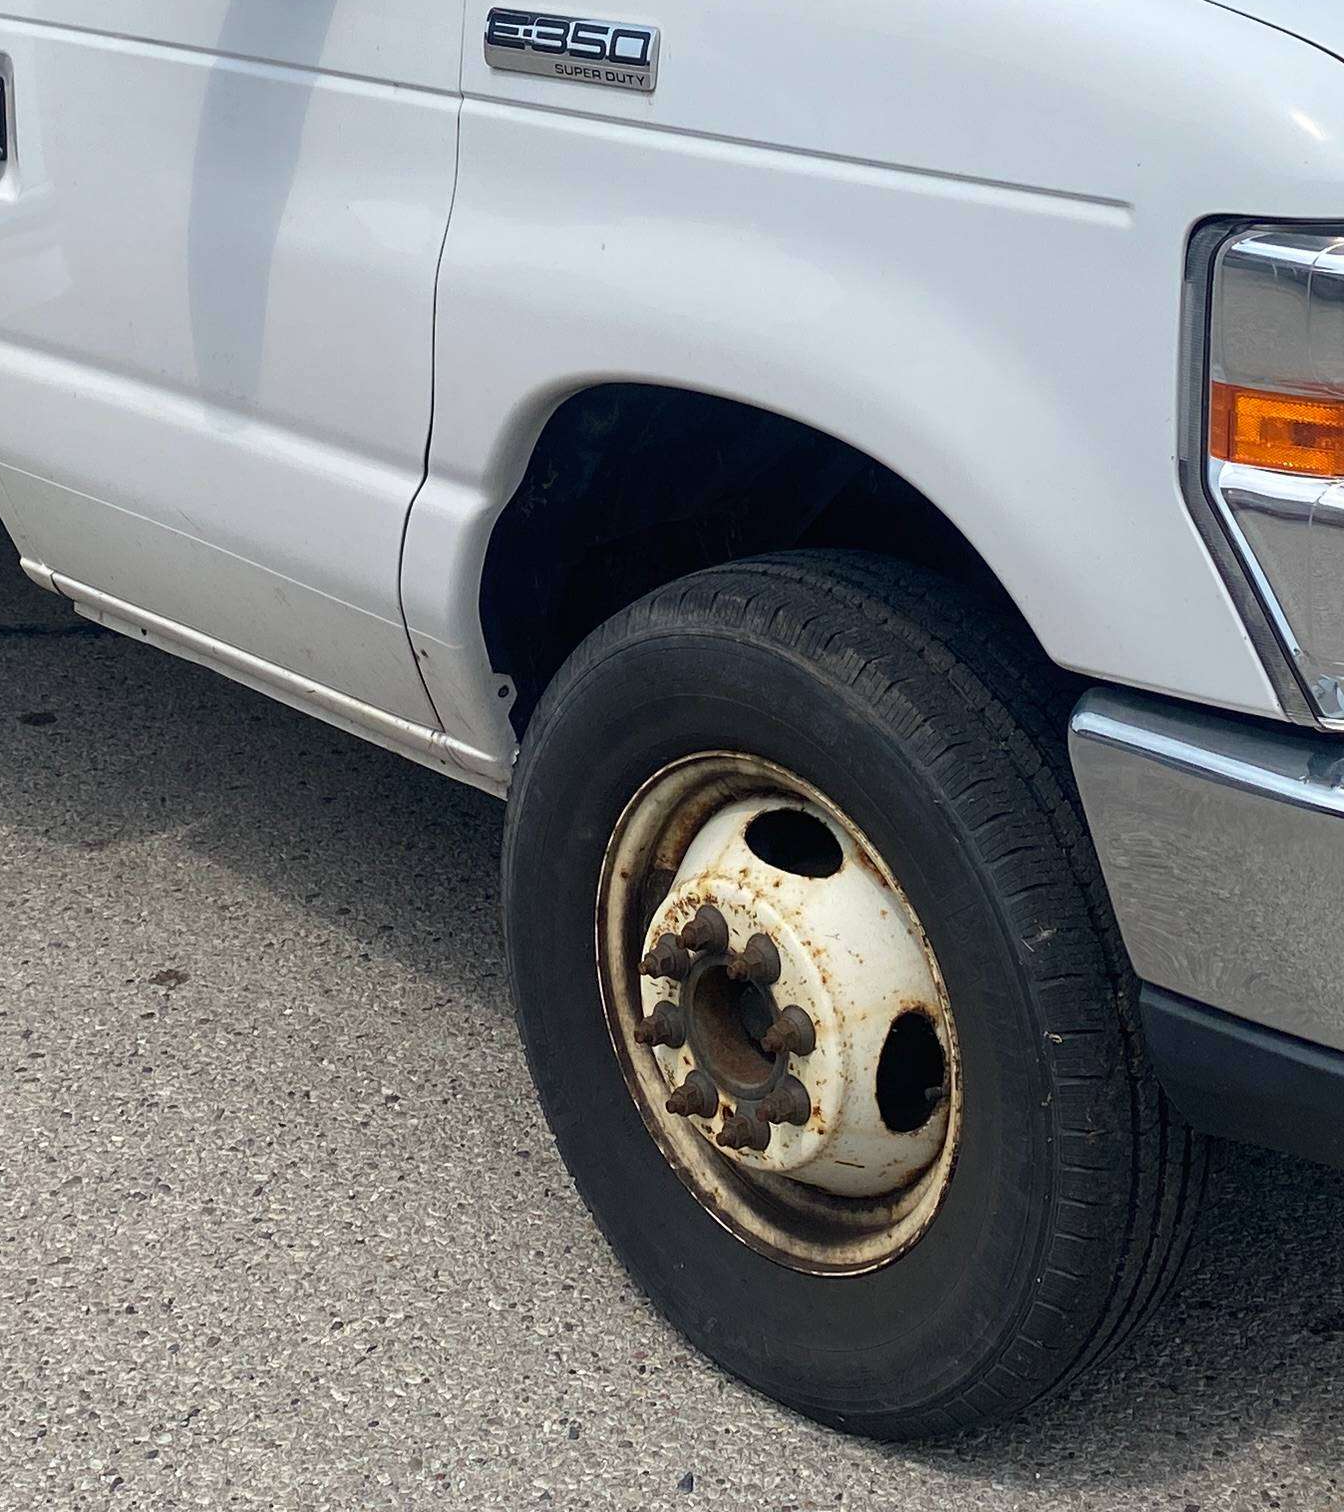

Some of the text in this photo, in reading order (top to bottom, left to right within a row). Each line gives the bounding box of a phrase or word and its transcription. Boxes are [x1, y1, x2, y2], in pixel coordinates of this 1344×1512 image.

[486, 12, 652, 67] E-350
[555, 63, 646, 87] SUPER DUTY
